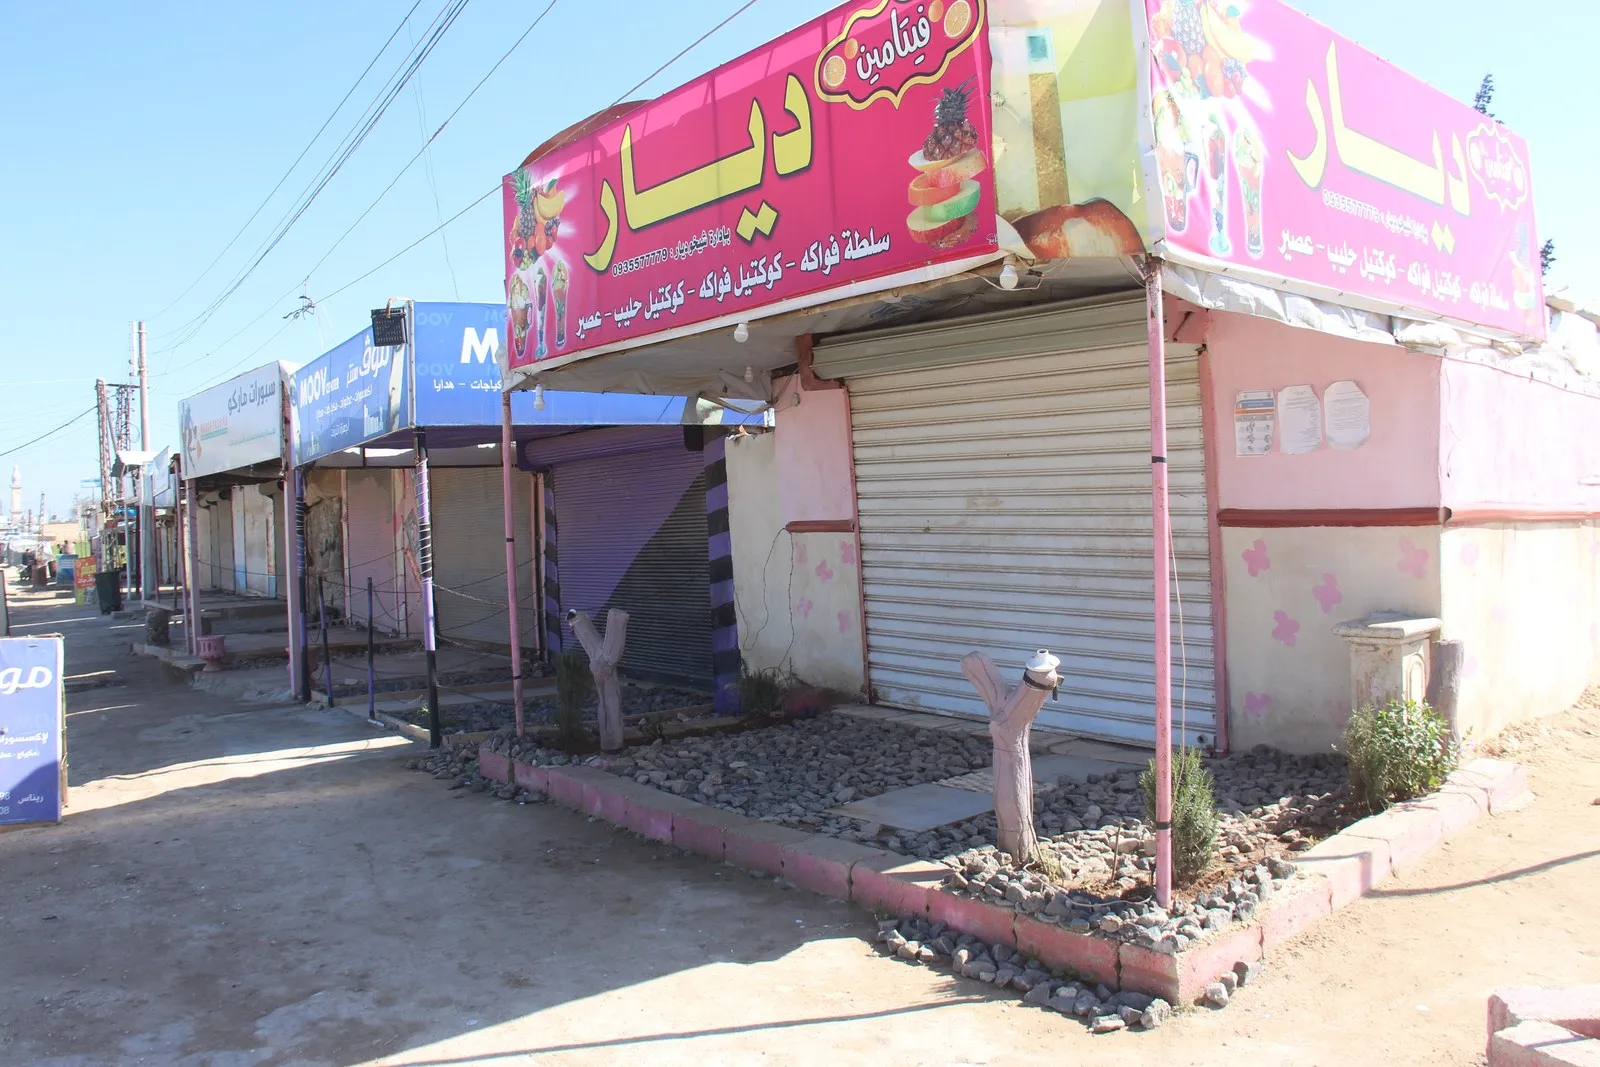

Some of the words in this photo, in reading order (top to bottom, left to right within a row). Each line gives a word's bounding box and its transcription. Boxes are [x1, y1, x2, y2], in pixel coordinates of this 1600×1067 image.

[855, 4, 932, 86] فيتامين
[1286, 39, 1472, 256] ديار
[583, 73, 813, 272] ديار
[800, 234, 840, 275] فواكه
[843, 227, 891, 261] سلطة
[1278, 229, 1315, 263] عصير
[1326, 240, 1358, 275] حليب
[612, 247, 669, 277] 0935577779
[733, 250, 783, 297] كوكتيل
[1359, 246, 1397, 286] كوكتيل
[644, 280, 685, 320] كوكتيل
[699, 266, 732, 302] فواكه
[575, 310, 603, 339] عصير
[614, 297, 643, 328] حليب
[460, 326, 499, 364] M
[299, 366, 328, 408] MOOV
[433, 378, 455, 393] هدايا
[470, 378, 502, 393] كياجات
[0, 665, 53, 695] مو
[0, 806, 10, 815] 08
